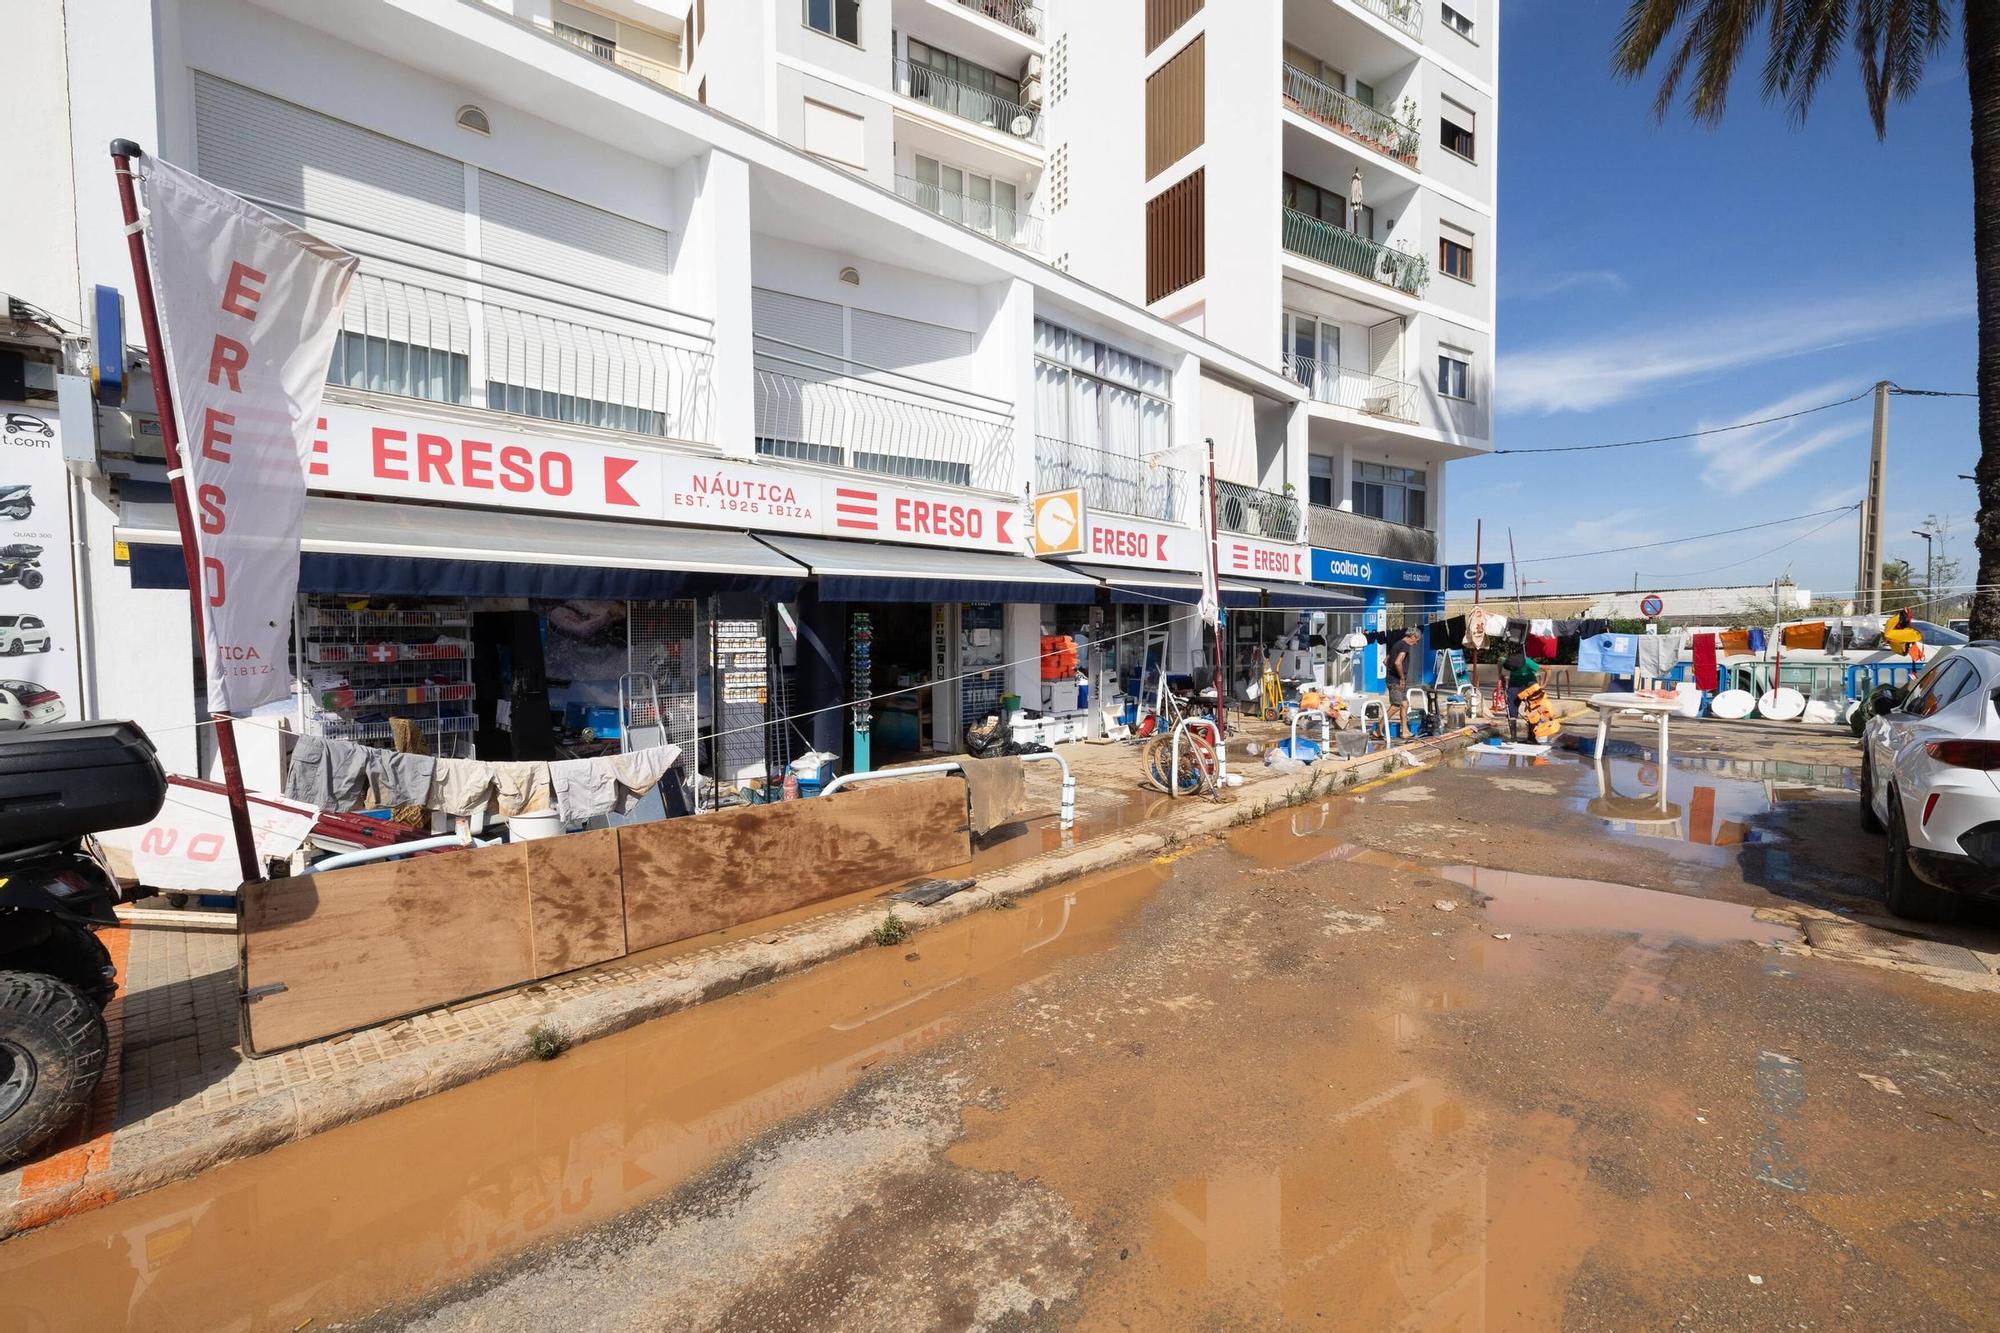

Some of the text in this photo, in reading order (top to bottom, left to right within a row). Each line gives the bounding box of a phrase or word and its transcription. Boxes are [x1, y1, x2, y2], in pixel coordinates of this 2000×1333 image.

[197, 260, 267, 608] ERESO
[371, 426, 574, 497] ERESO
[692, 471, 797, 504] NÁUTICA
[674, 493, 812, 519] EST. 1925 IBIZA
[895, 498, 983, 539] ERESO
[1092, 527, 1148, 558] ERESO
[1254, 549, 1289, 572] ERESO
[1330, 559, 1359, 577] cooltra
